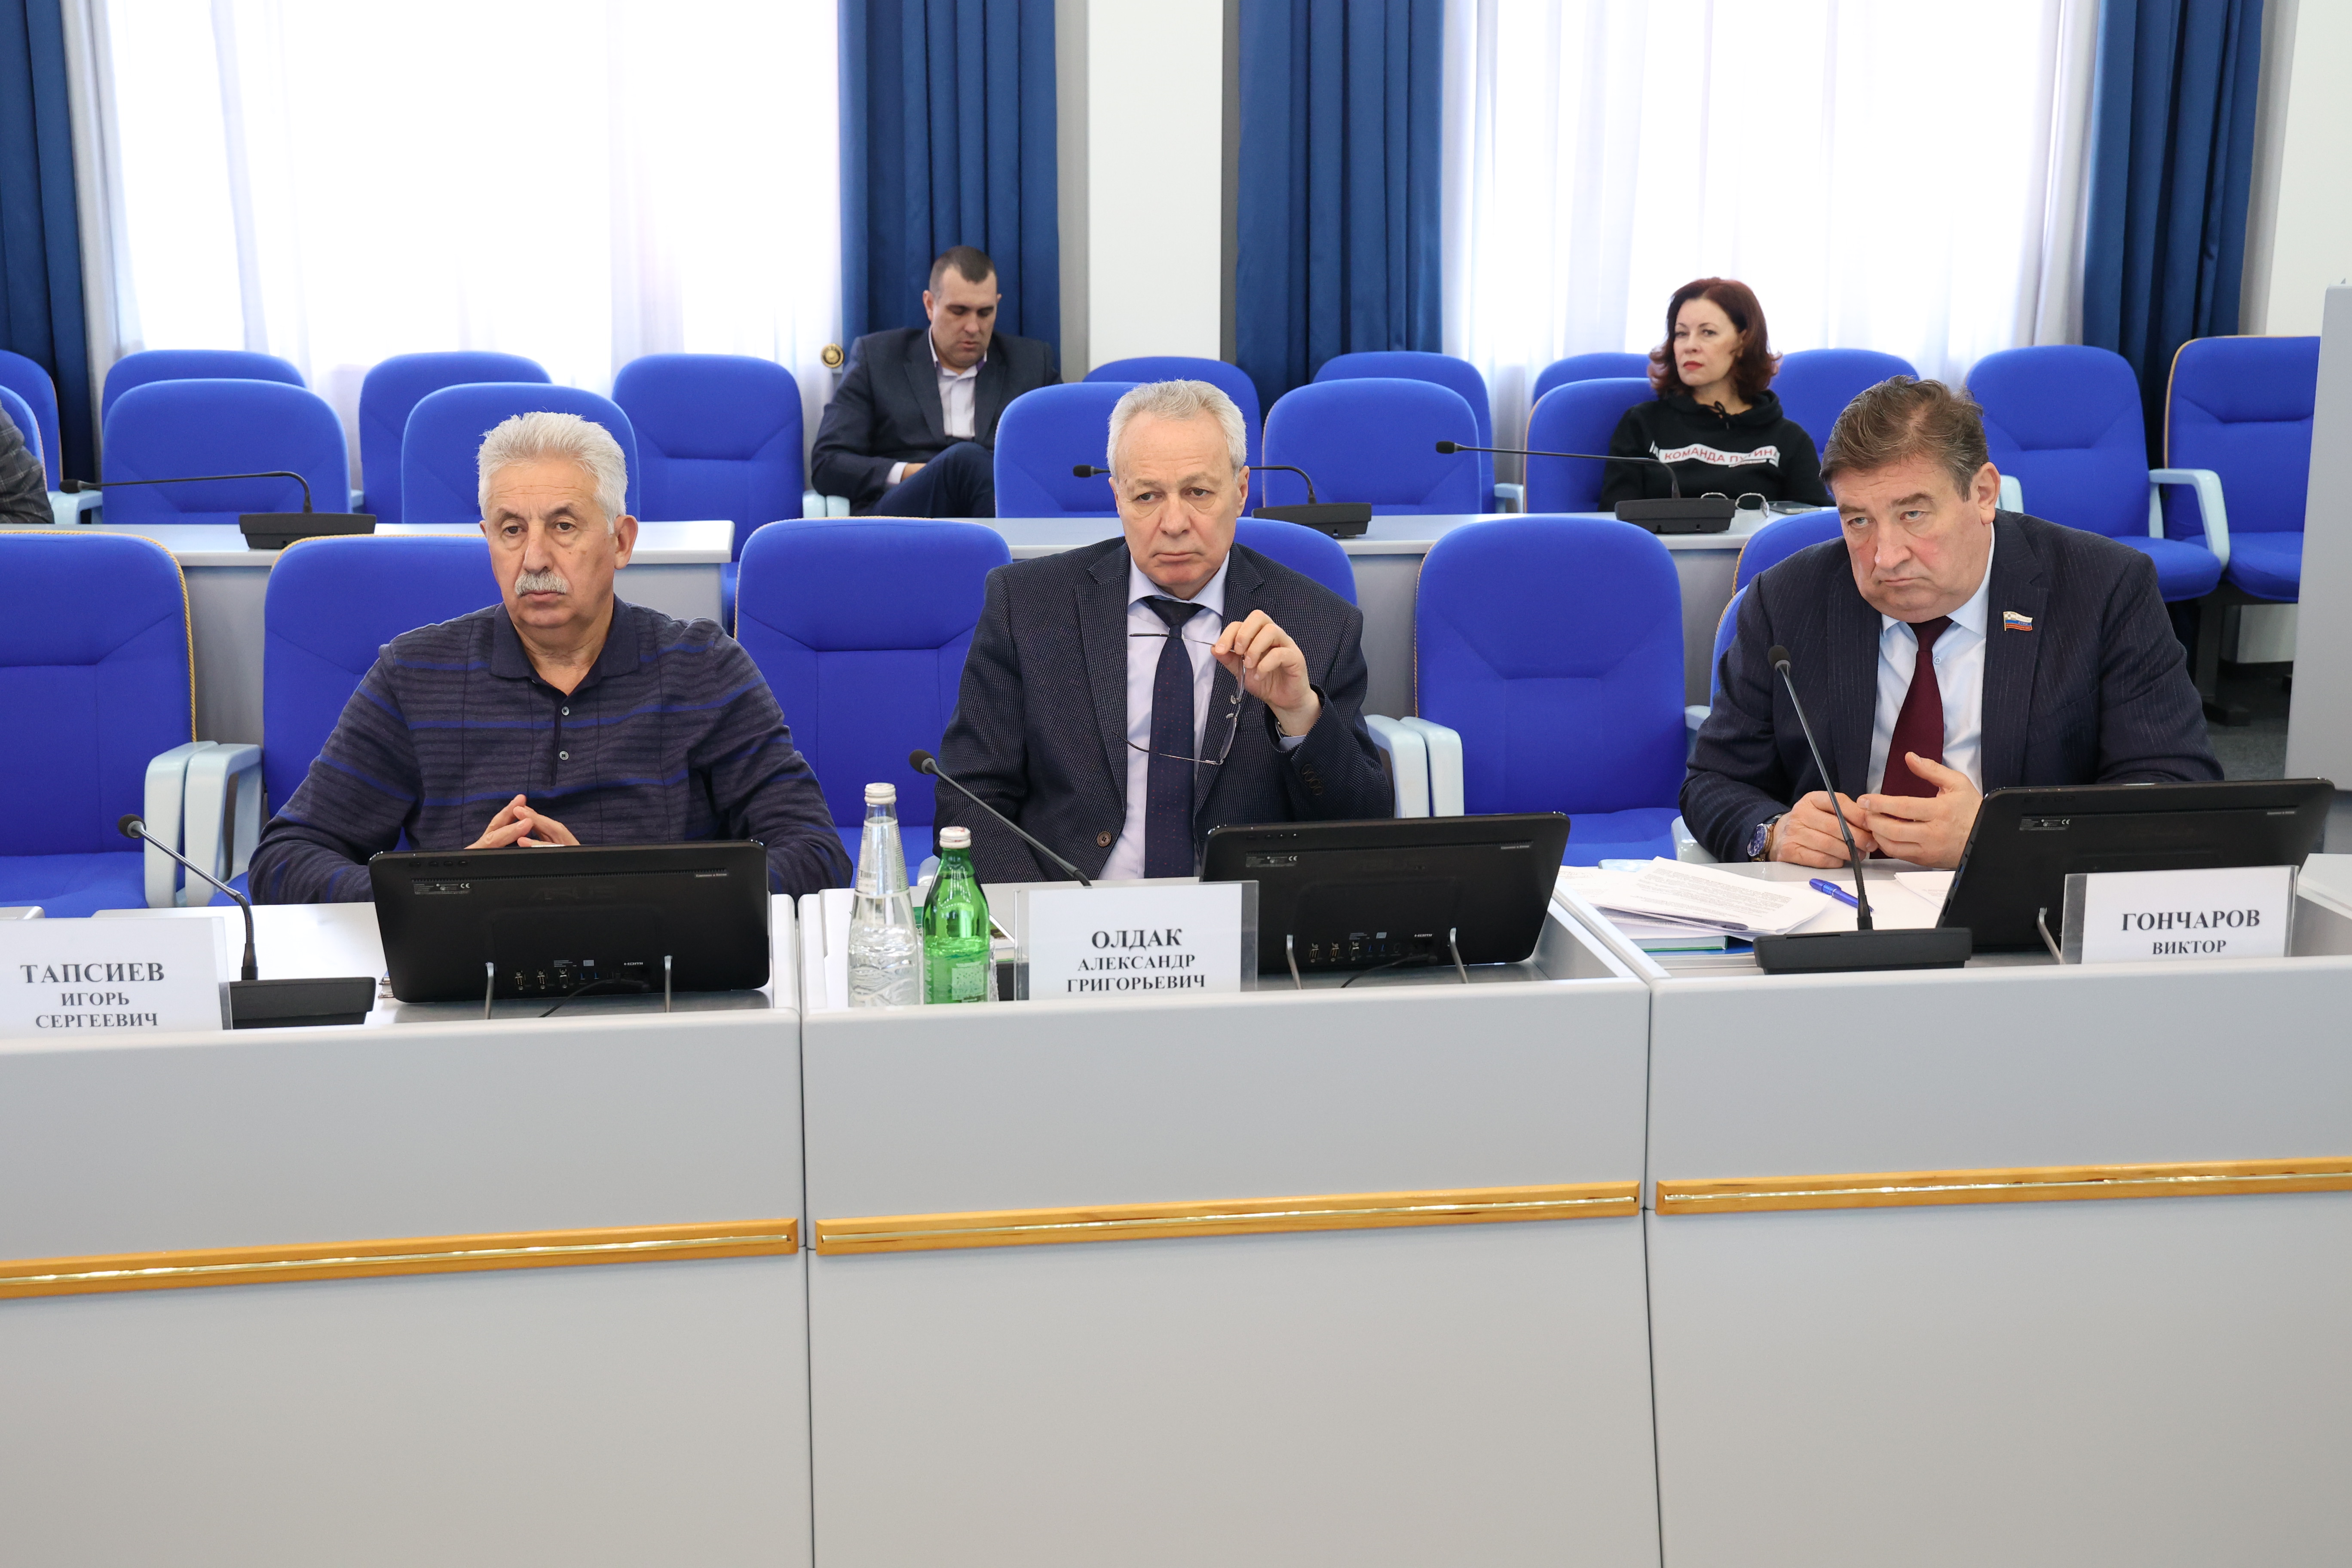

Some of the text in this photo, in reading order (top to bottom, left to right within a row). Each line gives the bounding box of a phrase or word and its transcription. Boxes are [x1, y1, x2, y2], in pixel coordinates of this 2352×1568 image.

[1664, 447, 1778, 462] КОМАНДА ПУИН
[2122, 909, 2260, 931] ГОНЧАРОВ
[1091, 928, 1182, 951] ОЛДАК
[2152, 940, 2226, 955] ВИКТОР
[1078, 954, 1195, 971] АЛЕКСАНДР
[20, 962, 165, 983] ТАПСИЕВ
[1067, 974, 1205, 992] ГРИГОРЬЕВИЧ
[61, 992, 130, 1006] ИГОРЬ
[36, 1013, 158, 1029] СЕРГЕЕВИЧ
